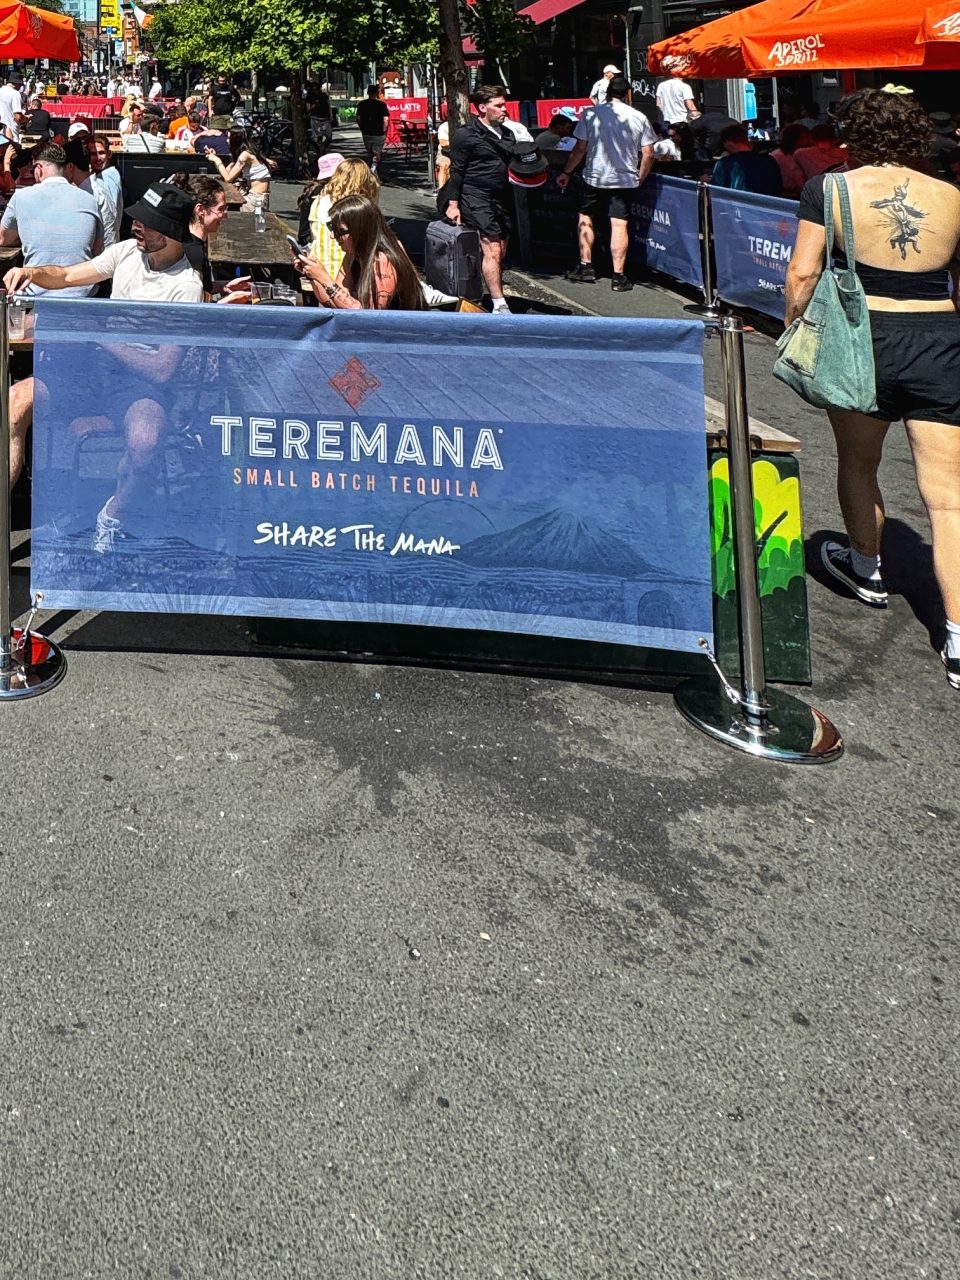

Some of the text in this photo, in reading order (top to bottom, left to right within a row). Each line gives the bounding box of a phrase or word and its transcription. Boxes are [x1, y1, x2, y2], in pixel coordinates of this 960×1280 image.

[768, 33, 825, 60] APEROL
[775, 50, 818, 67] SPRITZ
[748, 235, 792, 263] TEREM
[210, 415, 504, 471] TEREMANA
[233, 467, 480, 498] SMALL BATCH TEQUILA
[253, 521, 461, 556] SHARE THE MANA
